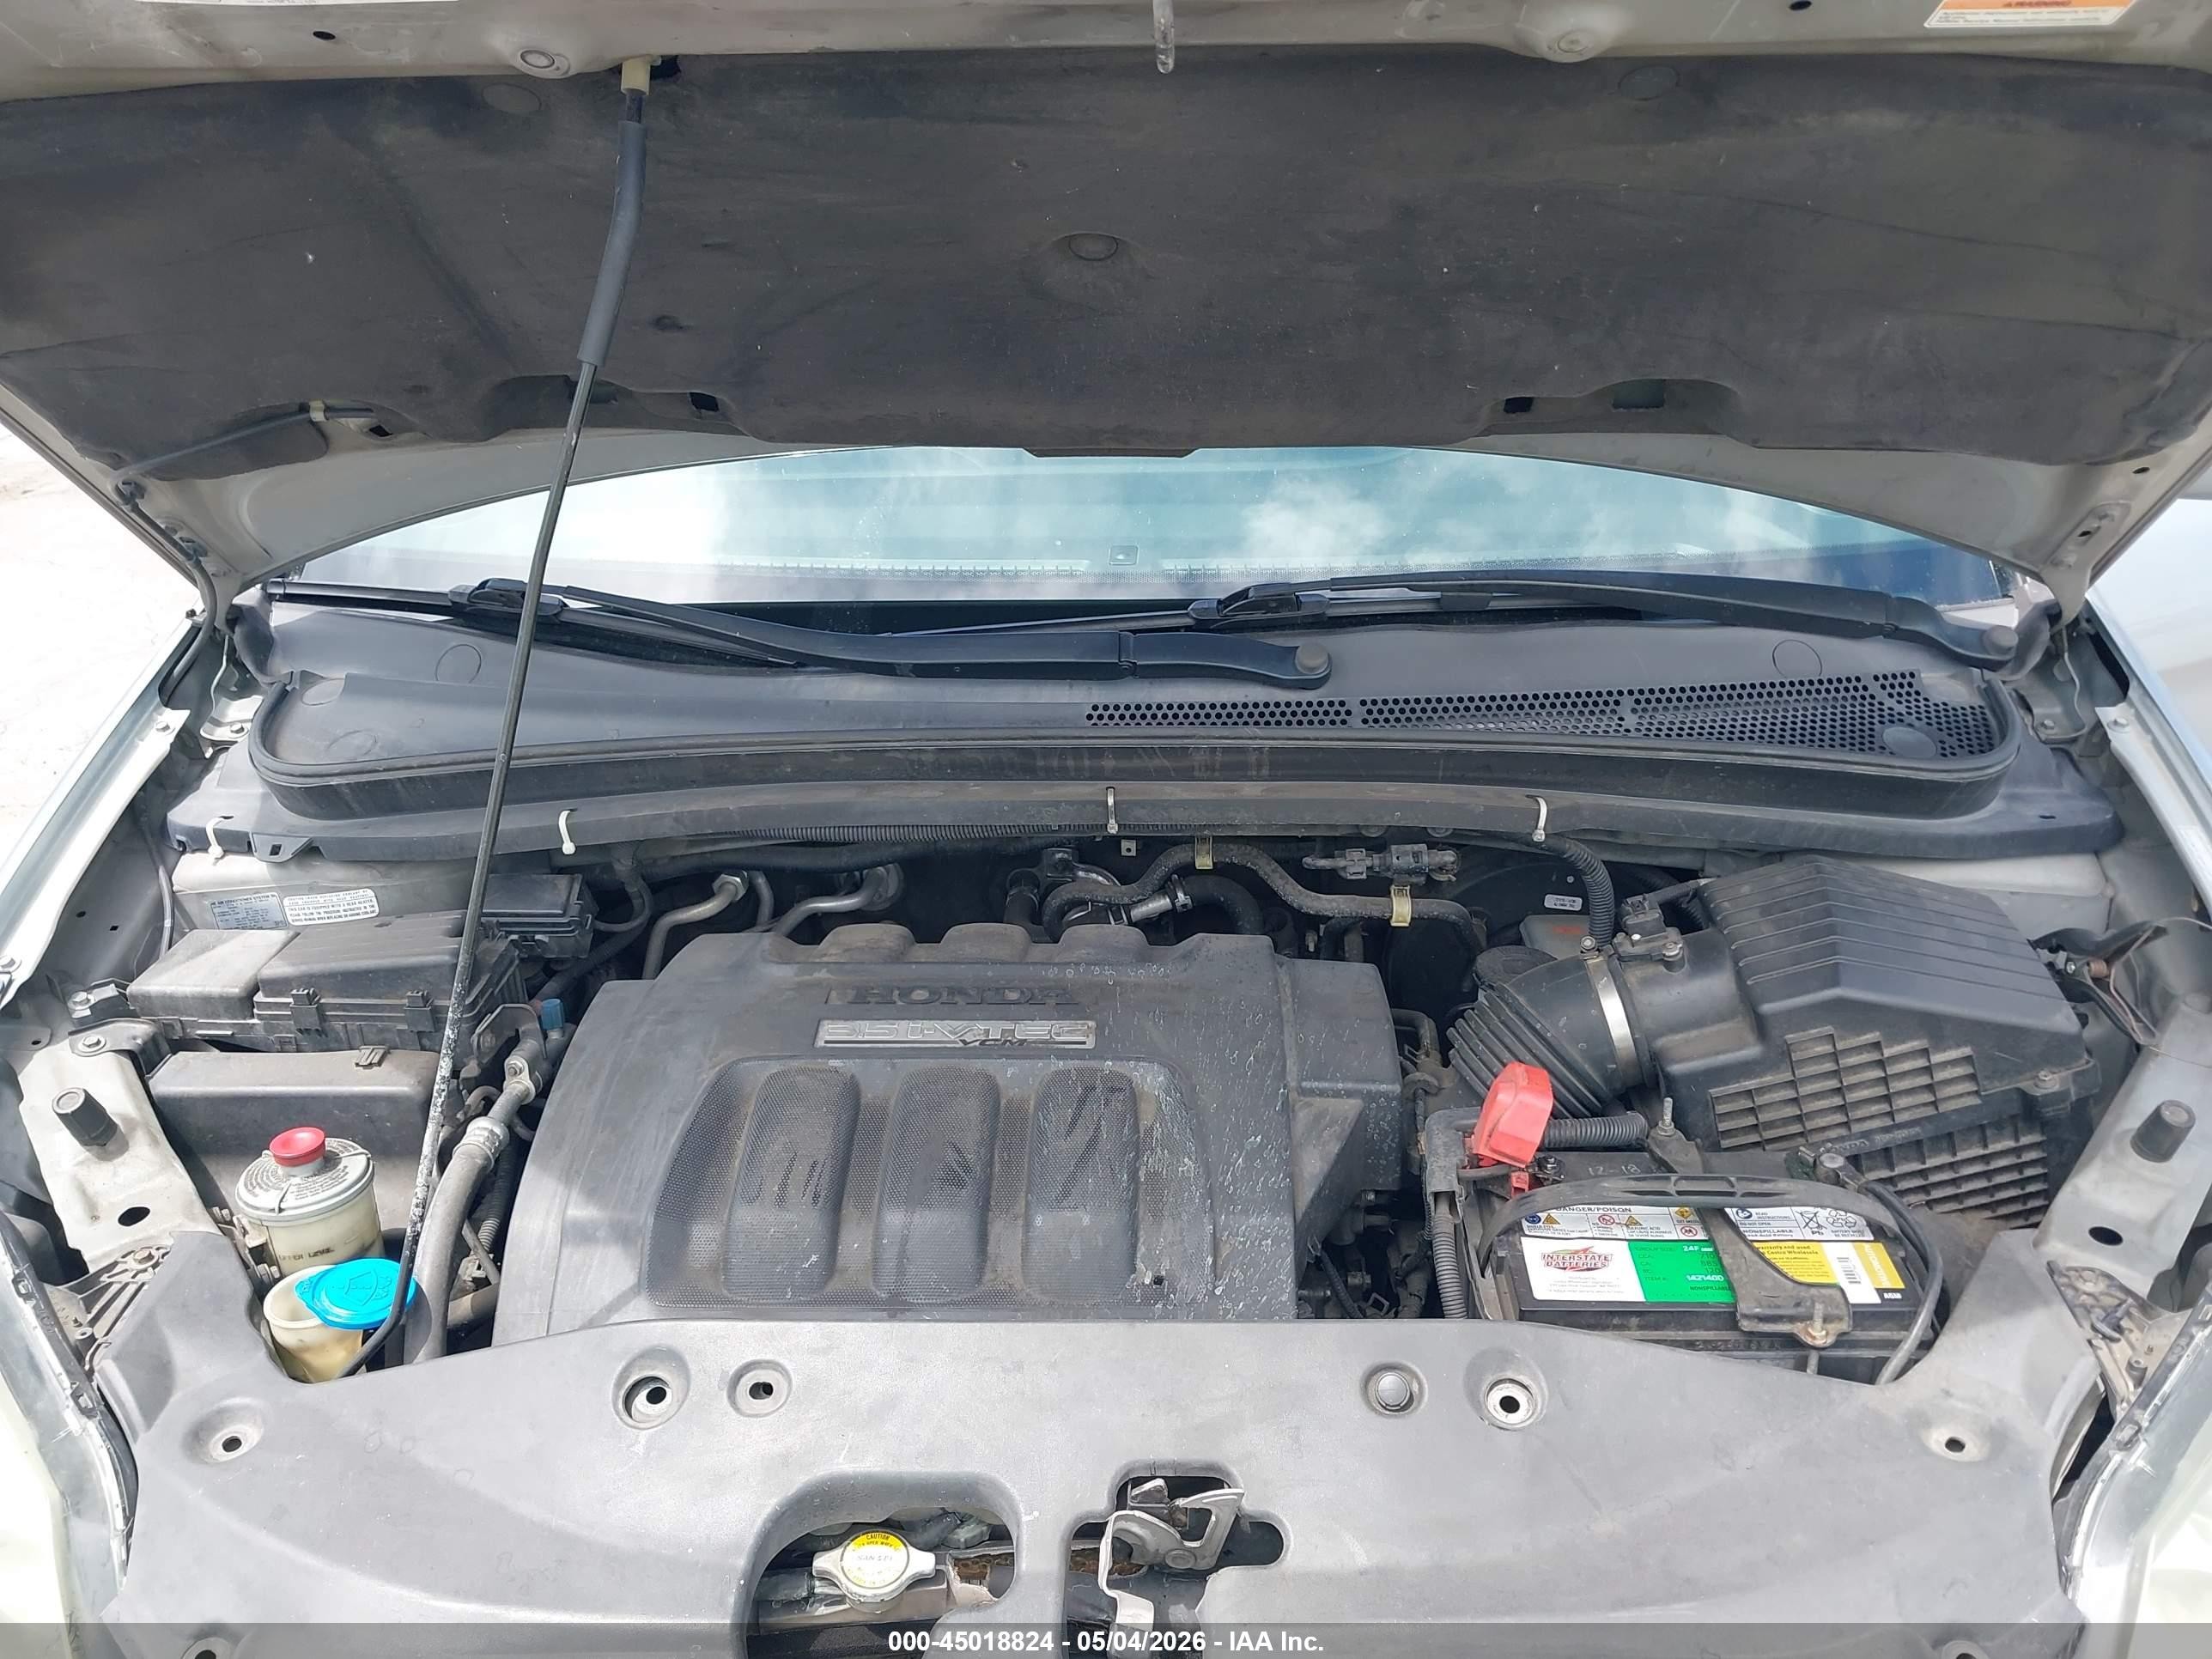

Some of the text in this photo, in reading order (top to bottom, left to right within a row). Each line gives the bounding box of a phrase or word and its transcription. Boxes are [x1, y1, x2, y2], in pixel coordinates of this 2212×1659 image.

[848, 987, 1079, 1005] HONDA
[823, 1022, 1088, 1040] 3.5 i-VTEC
[958, 1038, 1029, 1047] VCM
